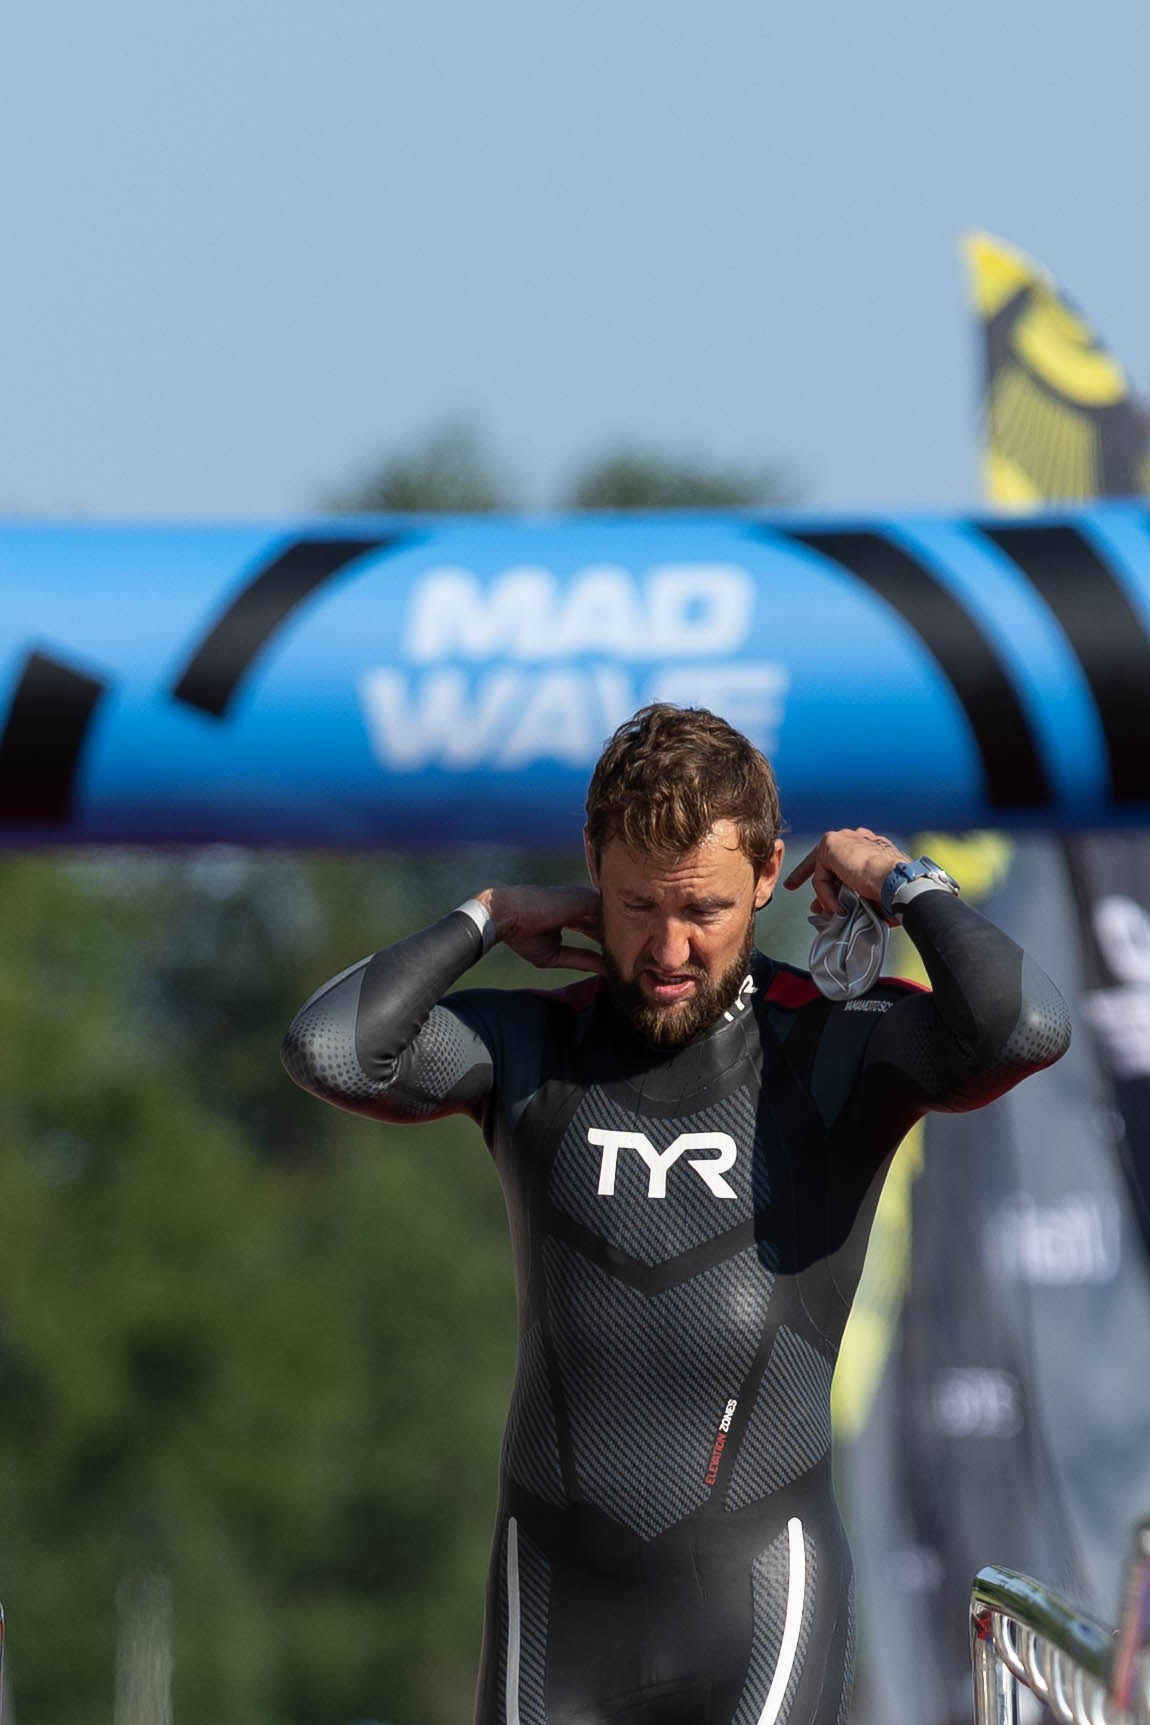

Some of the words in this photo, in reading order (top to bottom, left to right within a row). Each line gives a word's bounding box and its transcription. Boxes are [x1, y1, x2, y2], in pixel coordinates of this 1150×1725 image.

[405, 564, 756, 662] MAD
[587, 1128, 739, 1199] TYR
[719, 1399, 738, 1432] ZONES
